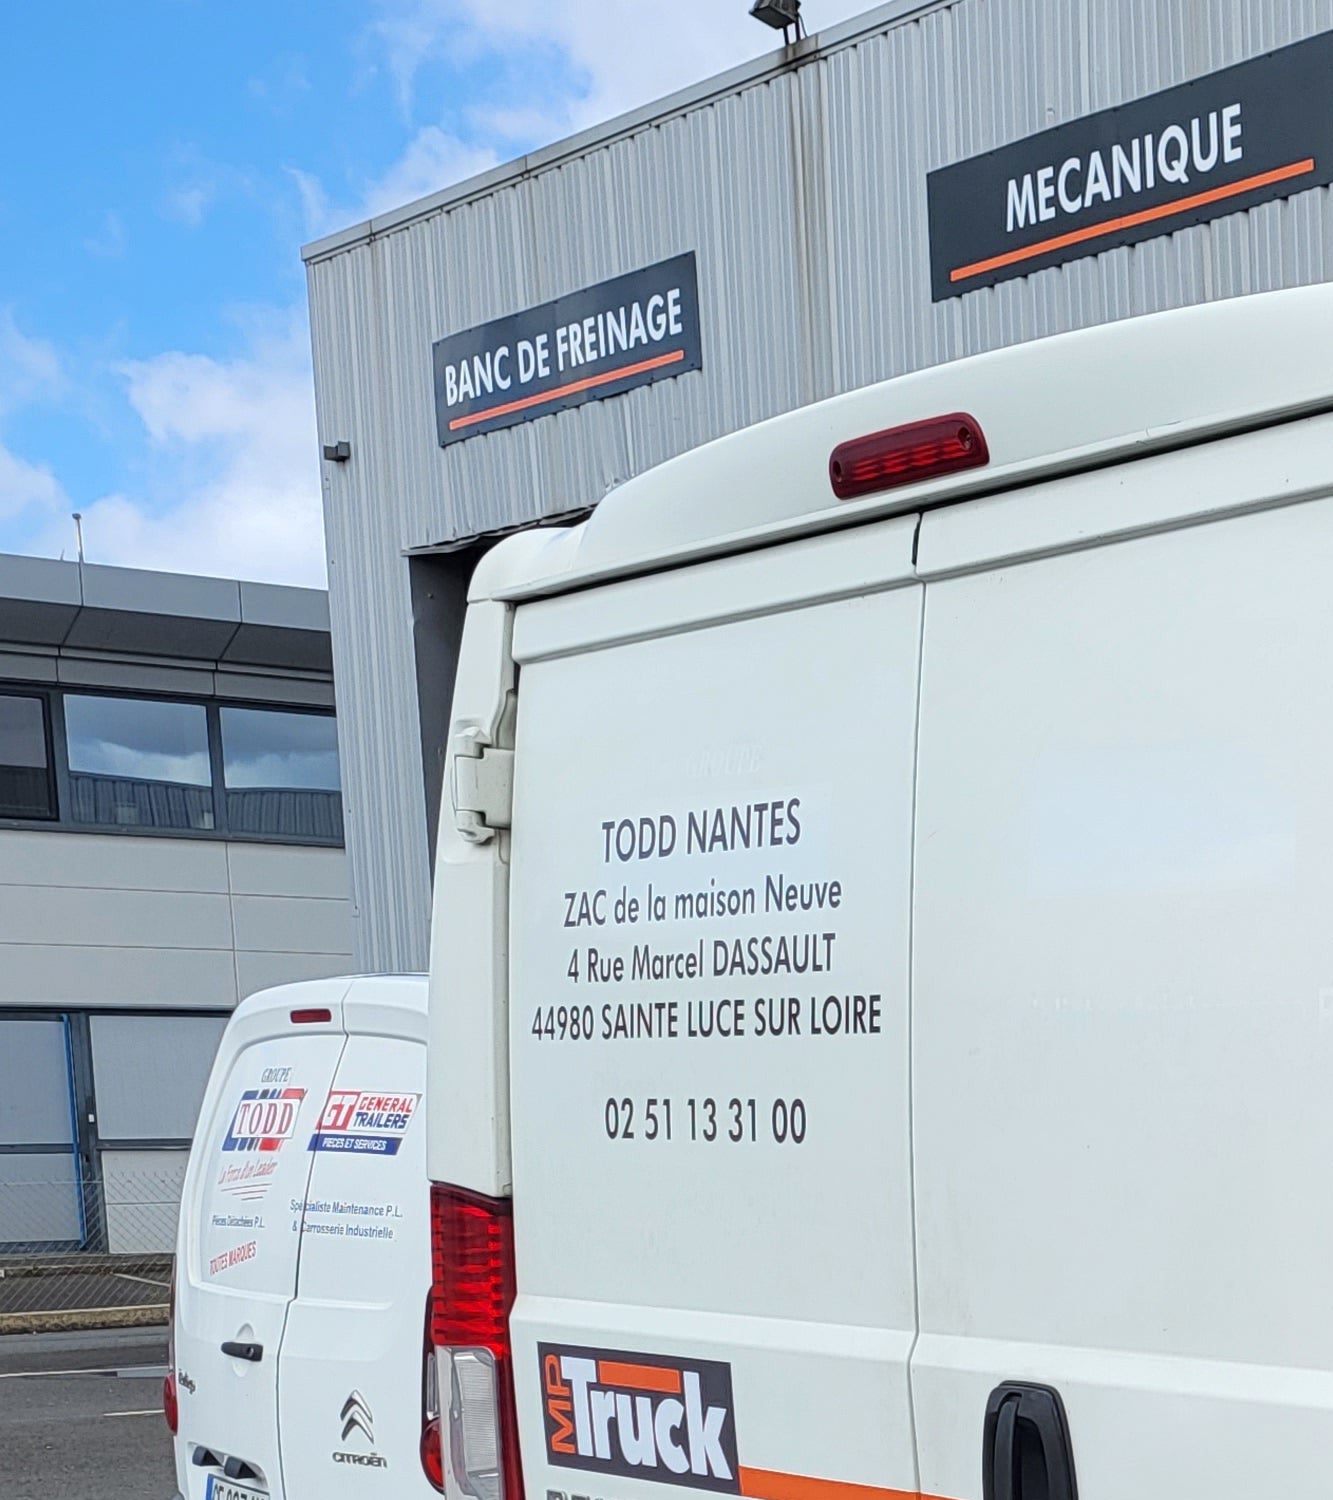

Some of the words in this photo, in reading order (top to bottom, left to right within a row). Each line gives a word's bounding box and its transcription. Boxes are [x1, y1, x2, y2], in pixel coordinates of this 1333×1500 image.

[1005, 101, 1244, 234] MECANIQUE
[445, 346, 511, 407] BANC
[517, 333, 550, 385] DE
[556, 287, 683, 372] FREINAGE
[601, 814, 677, 863] TODD
[687, 797, 801, 855] NANTES
[563, 889, 607, 928] ZAC
[614, 886, 639, 924] de
[647, 883, 666, 921] la
[674, 878, 755, 919] maison
[765, 873, 842, 913] Neuve
[567, 948, 579, 984] 4
[587, 947, 624, 983] Rue
[631, 938, 704, 981] Marcel
[713, 932, 836, 978] DASSAULT
[531, 1005, 594, 1041] 44980
[601, 1002, 678, 1040] SAINTE
[687, 999, 746, 1038] LUCE
[754, 996, 801, 1037] SUR
[810, 994, 881, 1035] LOIRE
[237, 1103, 293, 1135] TODD
[353, 1112, 410, 1129] TRAILERS
[358, 1096, 414, 1113] GENERAL
[605, 1098, 635, 1140] 02
[644, 1098, 671, 1140] 51
[687, 1098, 717, 1142] 13
[728, 1098, 757, 1143] 31
[771, 1098, 807, 1144] 00
[354, 1139, 387, 1151] SERVICES
[332, 1201, 385, 1216] Maintenance
[345, 1224, 394, 1239] Industrielle
[544, 1353, 576, 1455] MP
[560, 1355, 734, 1481] Truck
